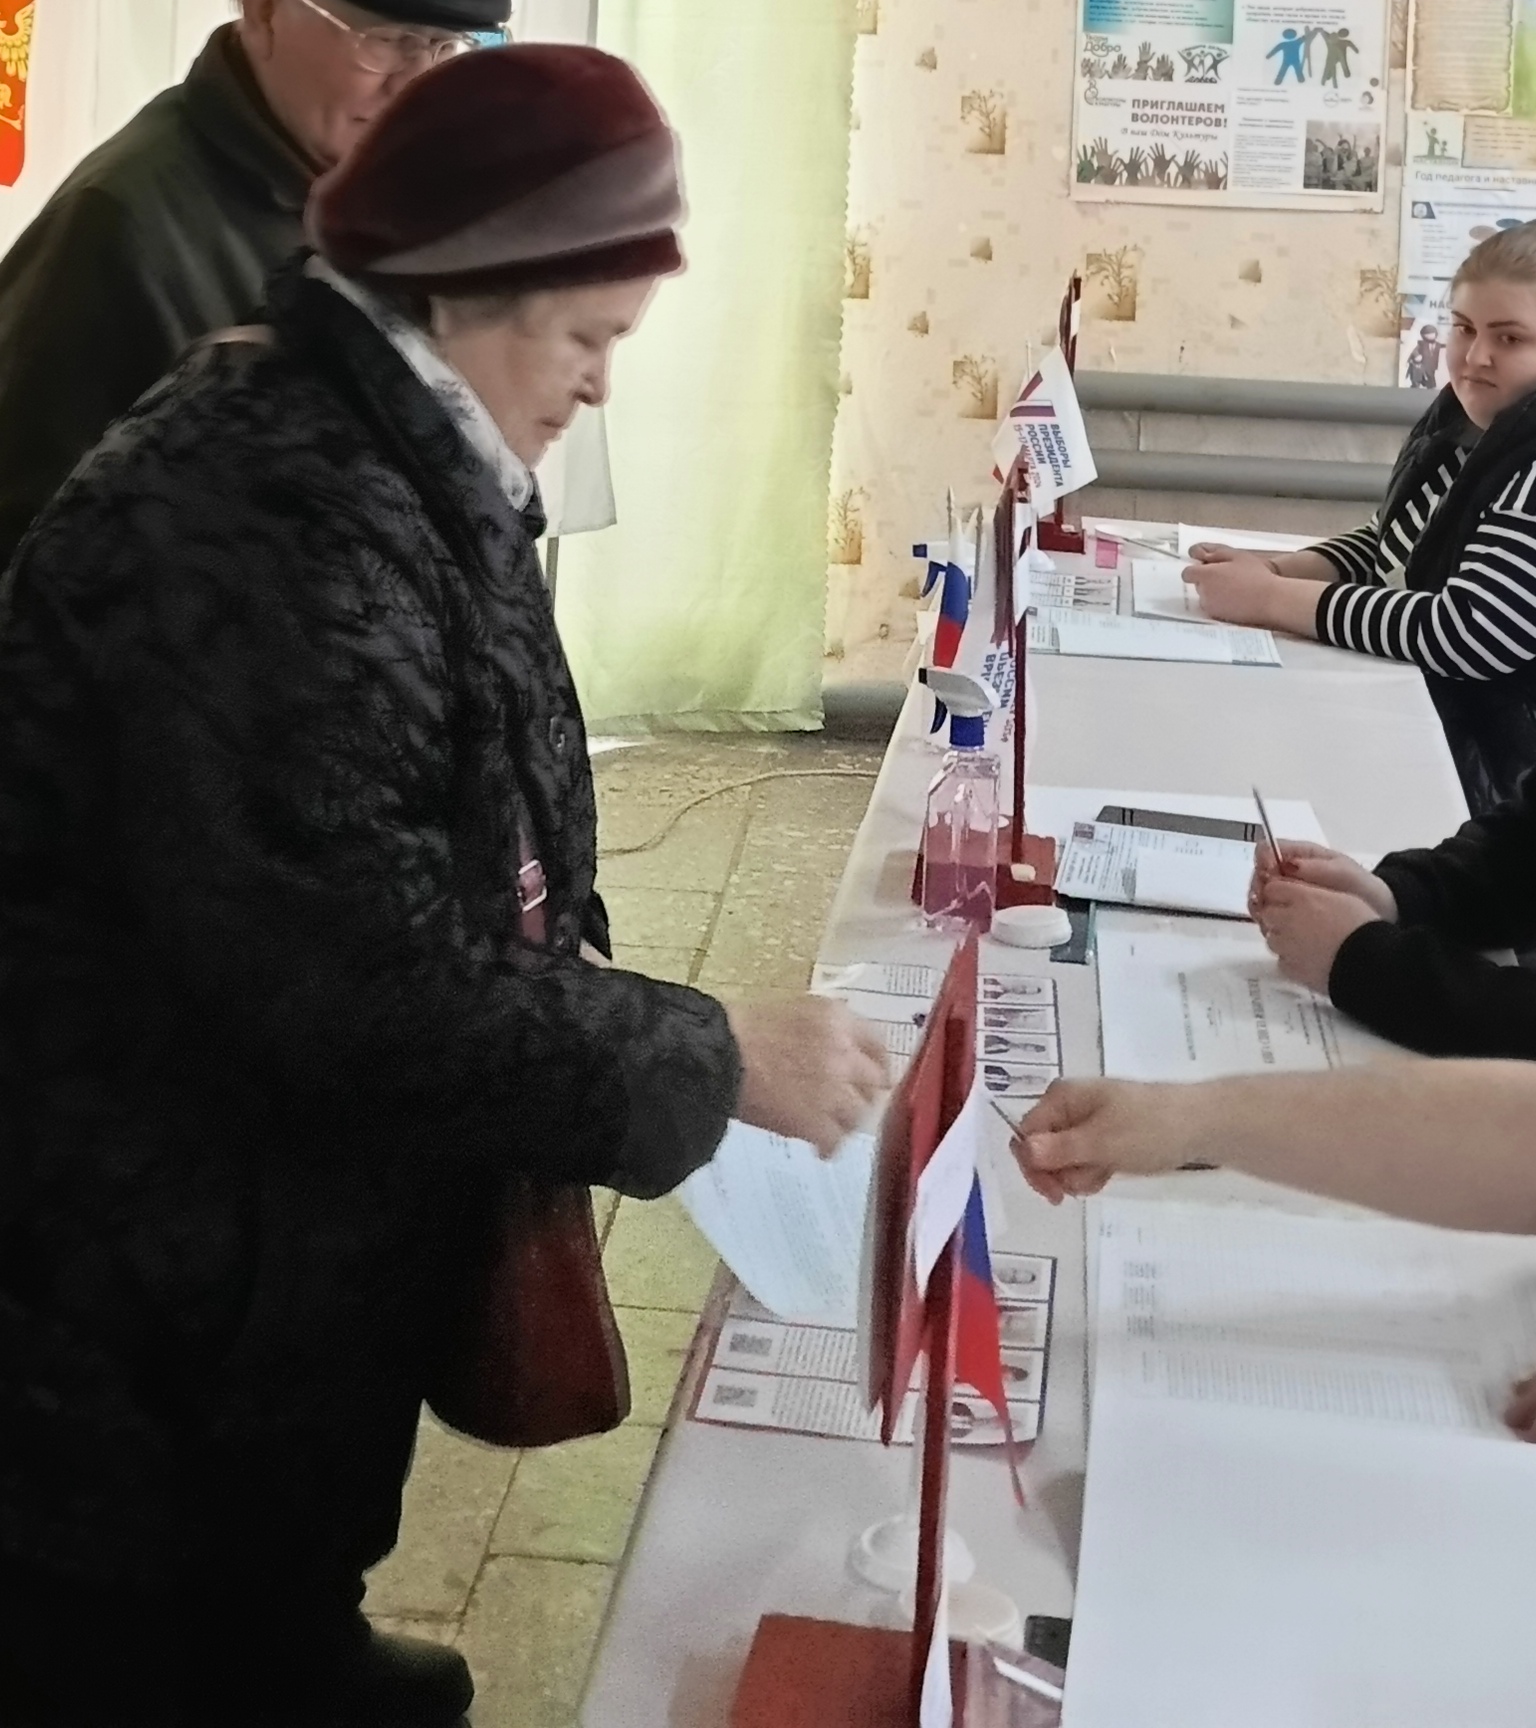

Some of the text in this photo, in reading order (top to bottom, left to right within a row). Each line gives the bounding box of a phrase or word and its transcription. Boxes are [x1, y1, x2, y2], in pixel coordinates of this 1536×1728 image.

[1130, 112, 1228, 128] ВОЛОНТЕРОВ!
[1131, 98, 1225, 114] ПРИГЛАШАЕМ
[1415, 170, 1434, 182] Год
[1435, 173, 1482, 184] педагога
[1025, 423, 1047, 465] РОССИИ
[1037, 423, 1064, 488] ПРЕЗИДЕНТА
[1050, 423, 1072, 468] ВЫБОРЫ
